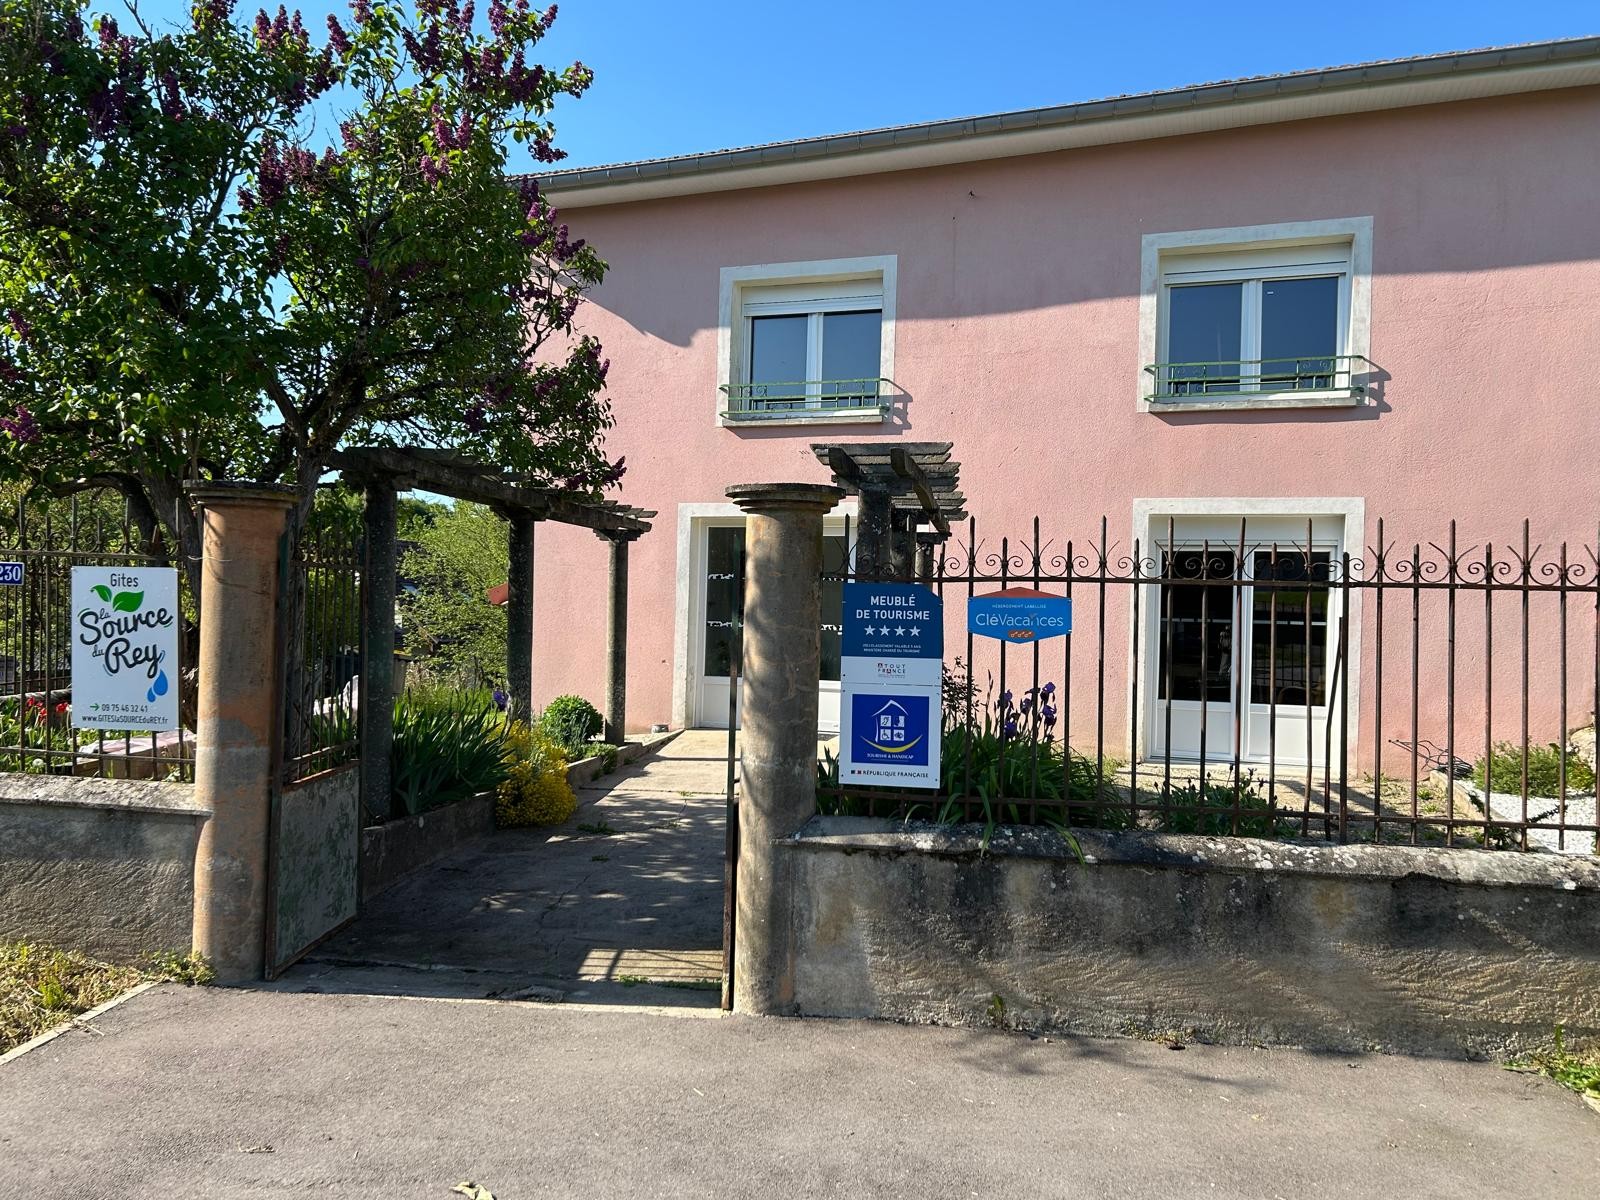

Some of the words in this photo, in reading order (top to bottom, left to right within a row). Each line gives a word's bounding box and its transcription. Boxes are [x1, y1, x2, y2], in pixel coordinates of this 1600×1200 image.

[110, 573, 139, 587] Gites
[870, 594, 916, 606] MEUBLÉ
[99, 608, 111, 620] la
[856, 609, 871, 619] DE
[873, 609, 930, 620] TOURISME
[975, 613, 1064, 627] CléVacances
[80, 608, 173, 645] Source
[92, 645, 105, 657] du
[105, 637, 161, 679] Rey
[101, 703, 110, 712] 09
[112, 704, 119, 712] 75
[121, 704, 129, 712] 46
[131, 704, 138, 712] 32
[140, 704, 148, 713] 41
[863, 769, 896, 777] RÉPUBLIQUE
